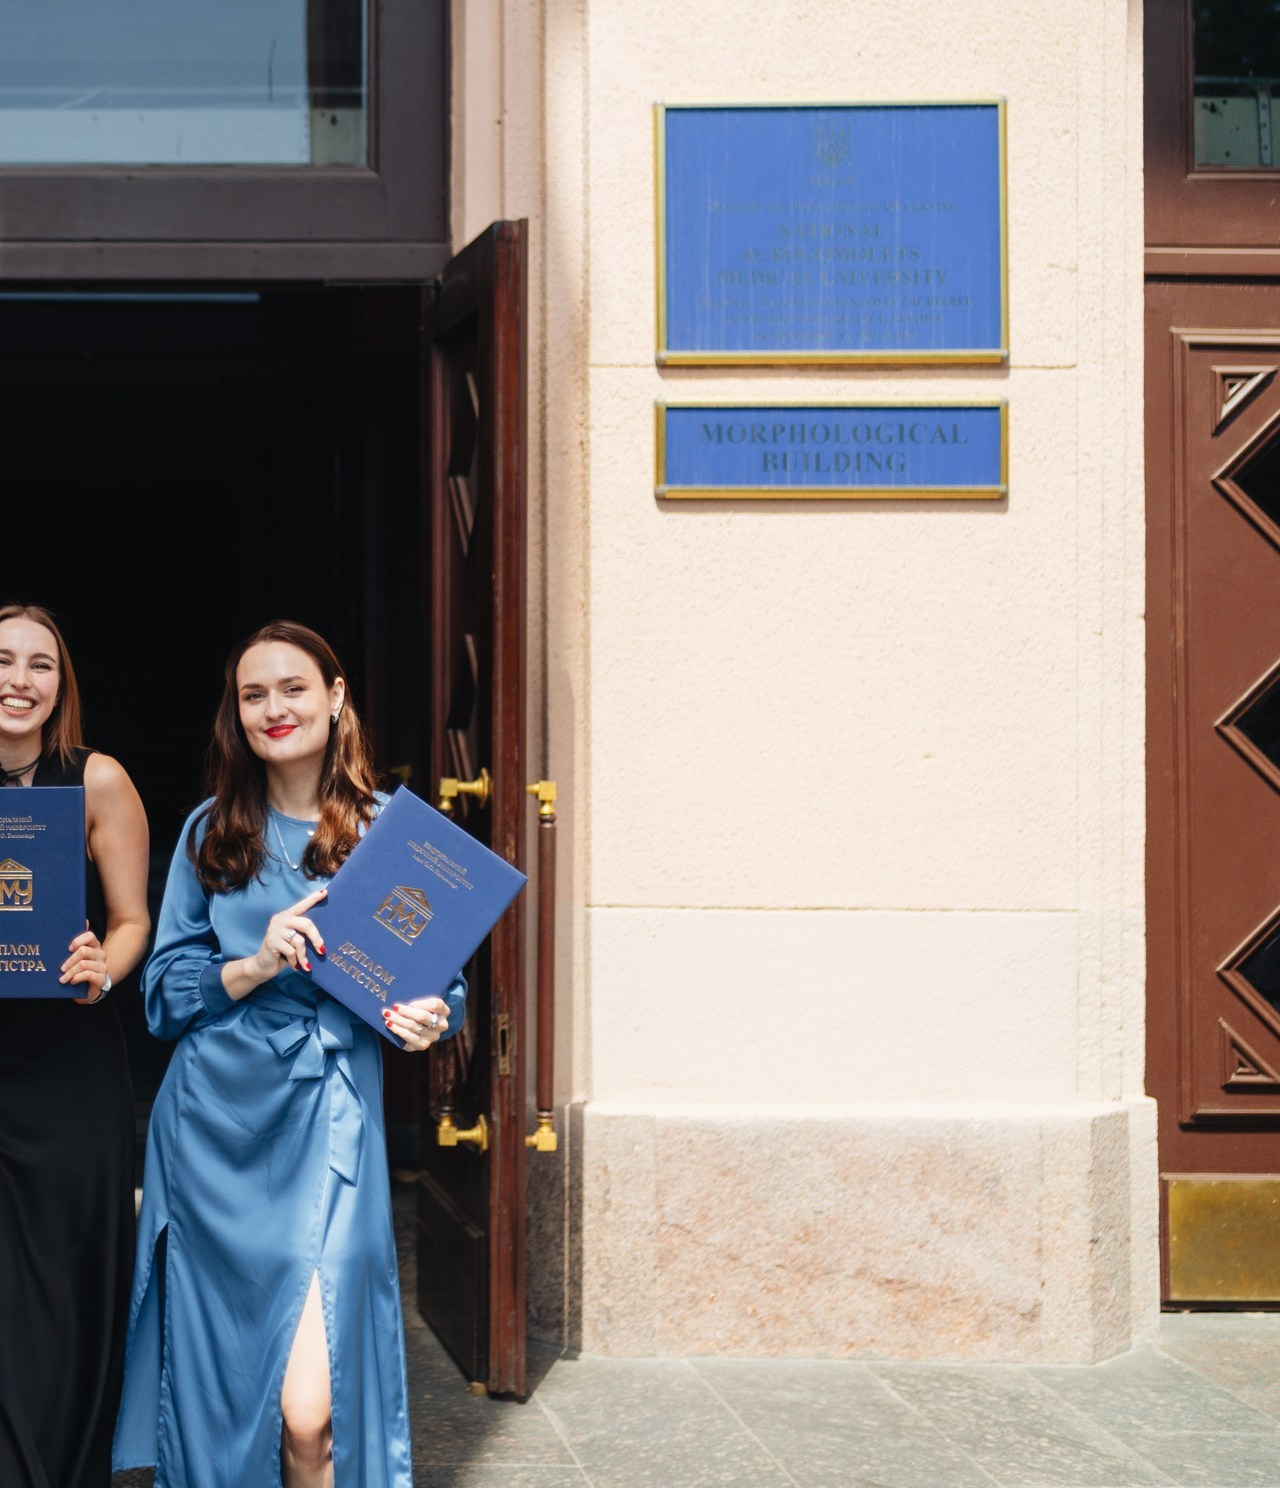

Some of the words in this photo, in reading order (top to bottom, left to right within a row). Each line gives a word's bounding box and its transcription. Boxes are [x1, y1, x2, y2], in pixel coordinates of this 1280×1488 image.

[778, 223, 884, 239] NATIONAL
[771, 246, 920, 263] BOGOMOLETS
[717, 270, 811, 287] MEDICAL
[820, 269, 949, 286] UNIVERSITY
[700, 423, 968, 445] MORPHOLOGICAL
[762, 452, 907, 473] BUILDING
[338, 942, 396, 986] ДИПЛОМ
[327, 952, 388, 1003] МАГІСТРА
